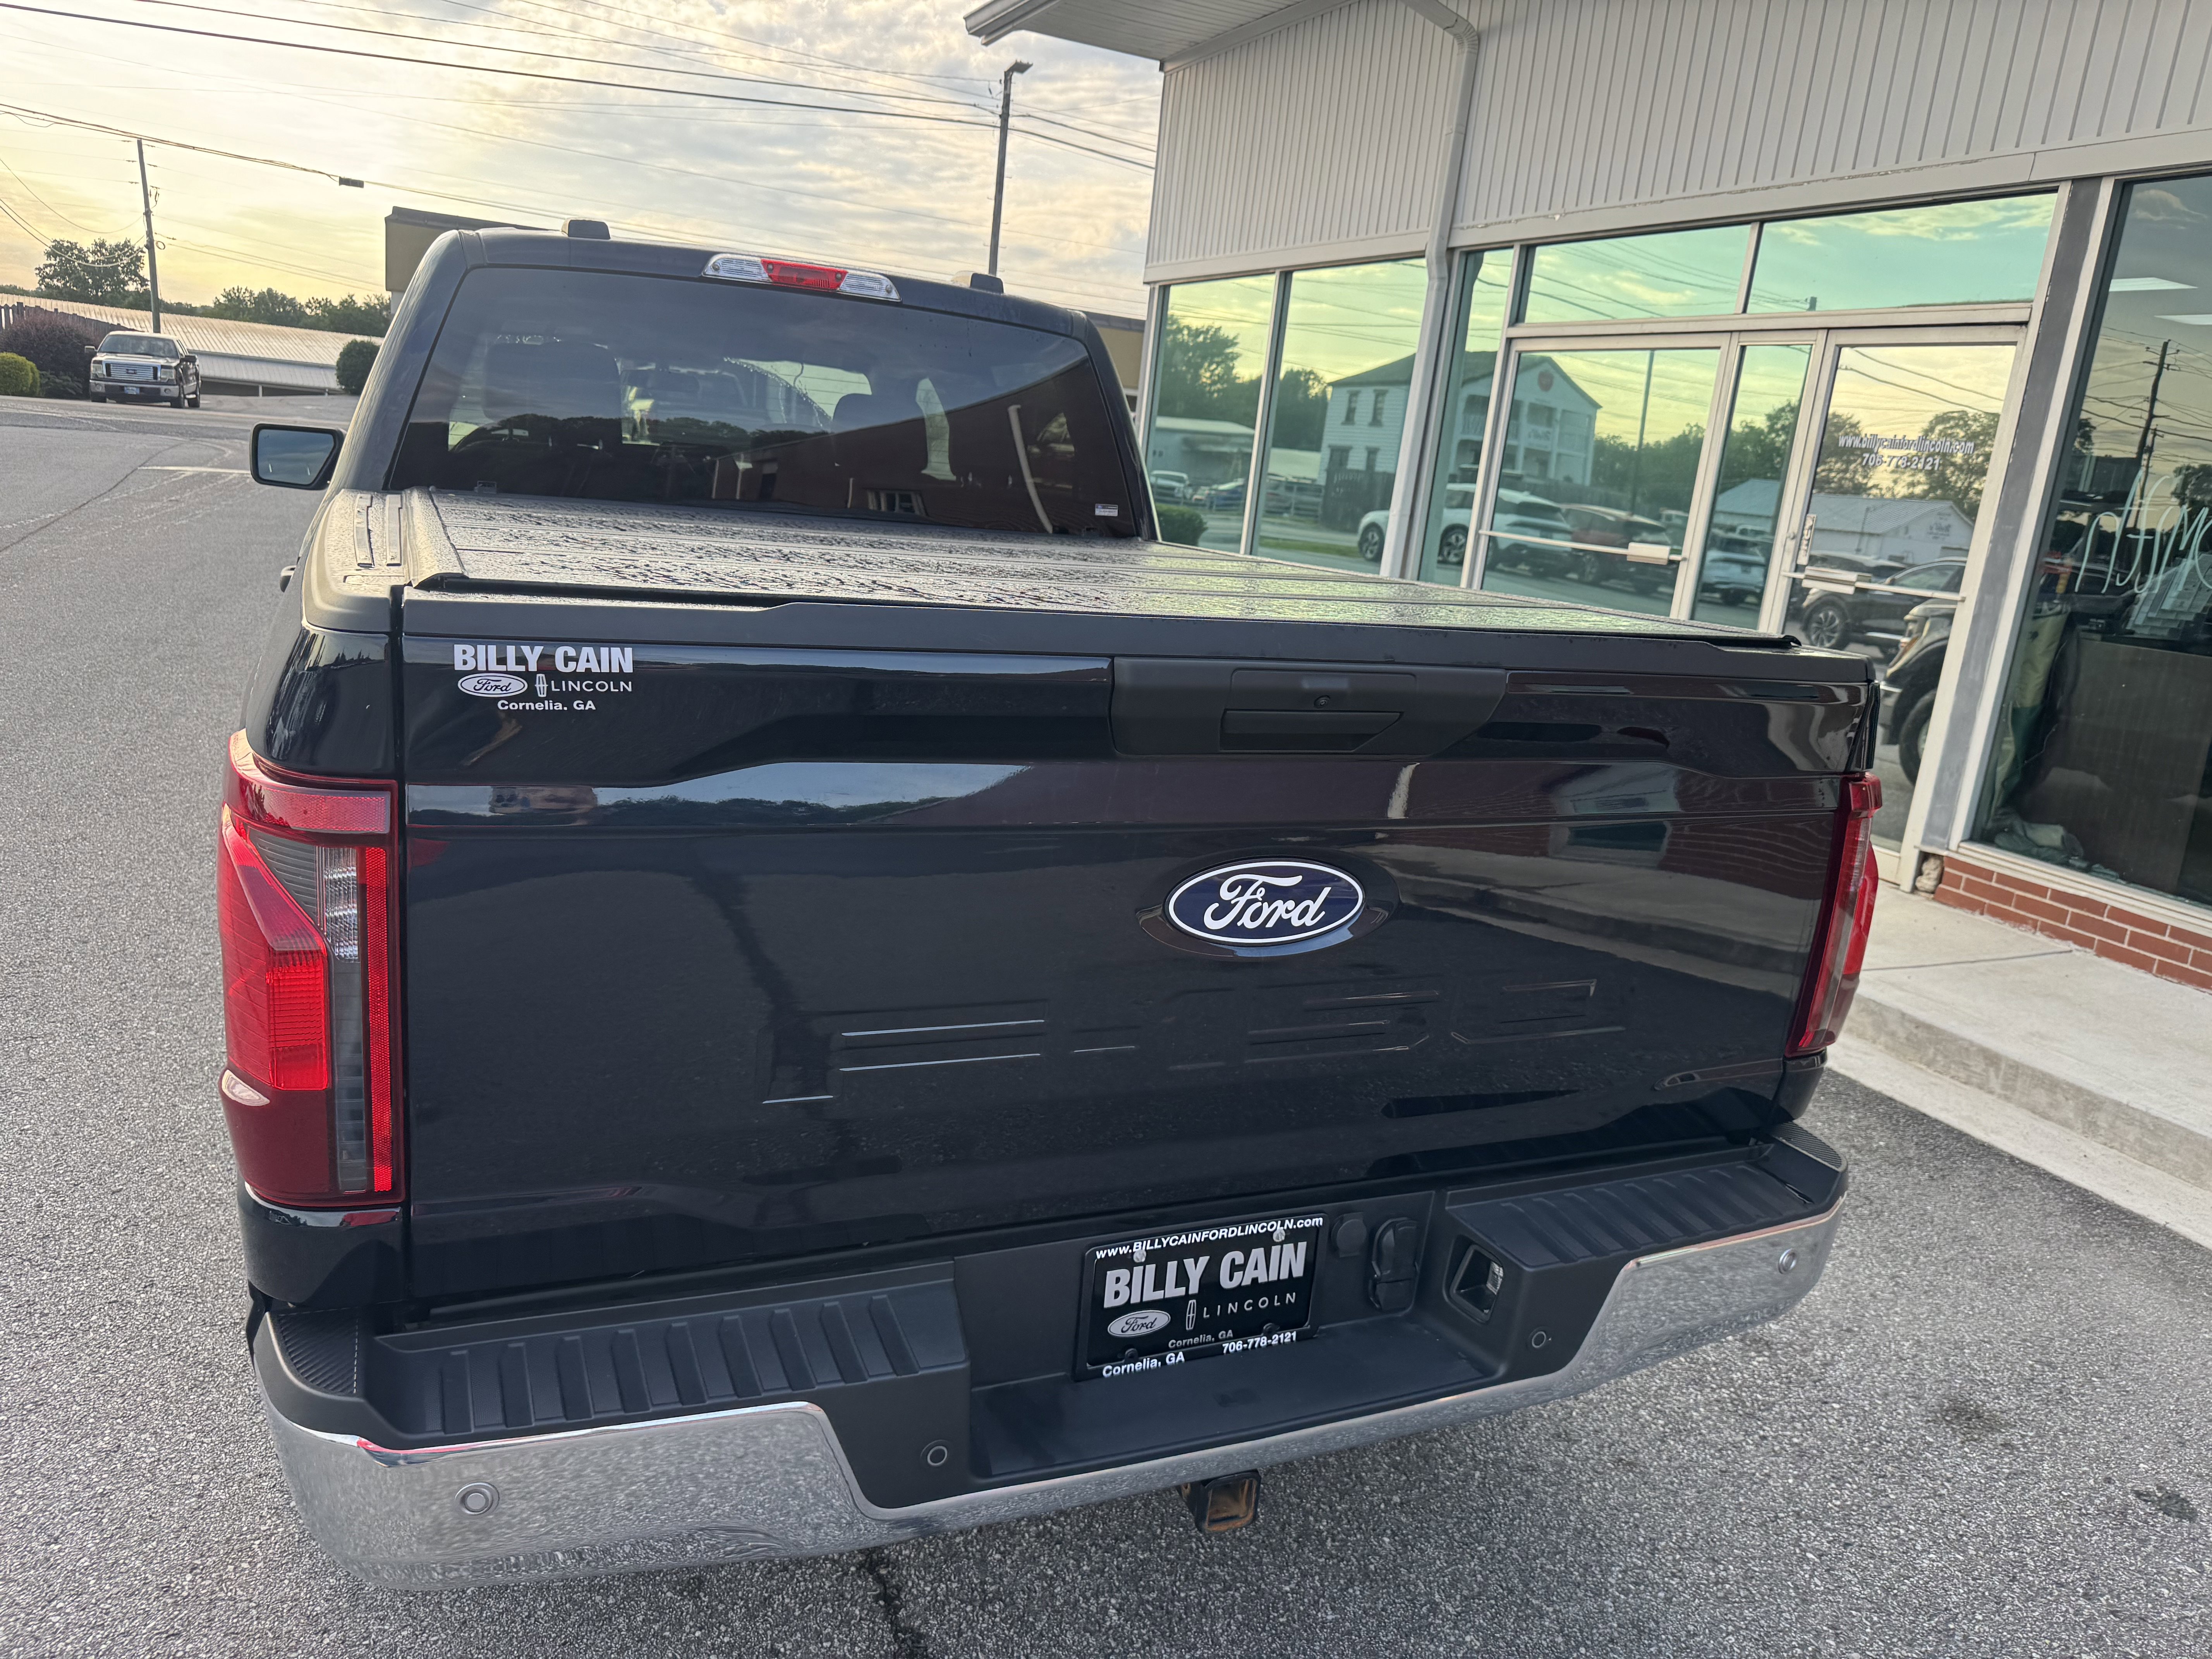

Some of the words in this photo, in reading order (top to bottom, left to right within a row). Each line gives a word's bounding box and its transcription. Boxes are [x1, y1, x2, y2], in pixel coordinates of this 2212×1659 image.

[1838, 433, 1974, 454] www.billycainfordlincoln.com
[453, 644, 544, 672] BILLY
[555, 646, 633, 673] CAIN
[551, 680, 632, 692] LINCOLN
[573, 700, 596, 710] GA
[1204, 874, 1331, 930] Ford
[1096, 1216, 1323, 1259] www.BILLYCAINFORDLINCOLN.com
[1104, 1255, 1210, 1309] BILLY
[1219, 1242, 1307, 1290] CAIN
[1203, 1292, 1296, 1319] LINCOLN
[1218, 1329, 1234, 1340] GA
[1222, 1331, 1297, 1354] 706-778-2121
[1102, 1358, 1161, 1378] Cornelia,
[1166, 1351, 1185, 1366] GA
